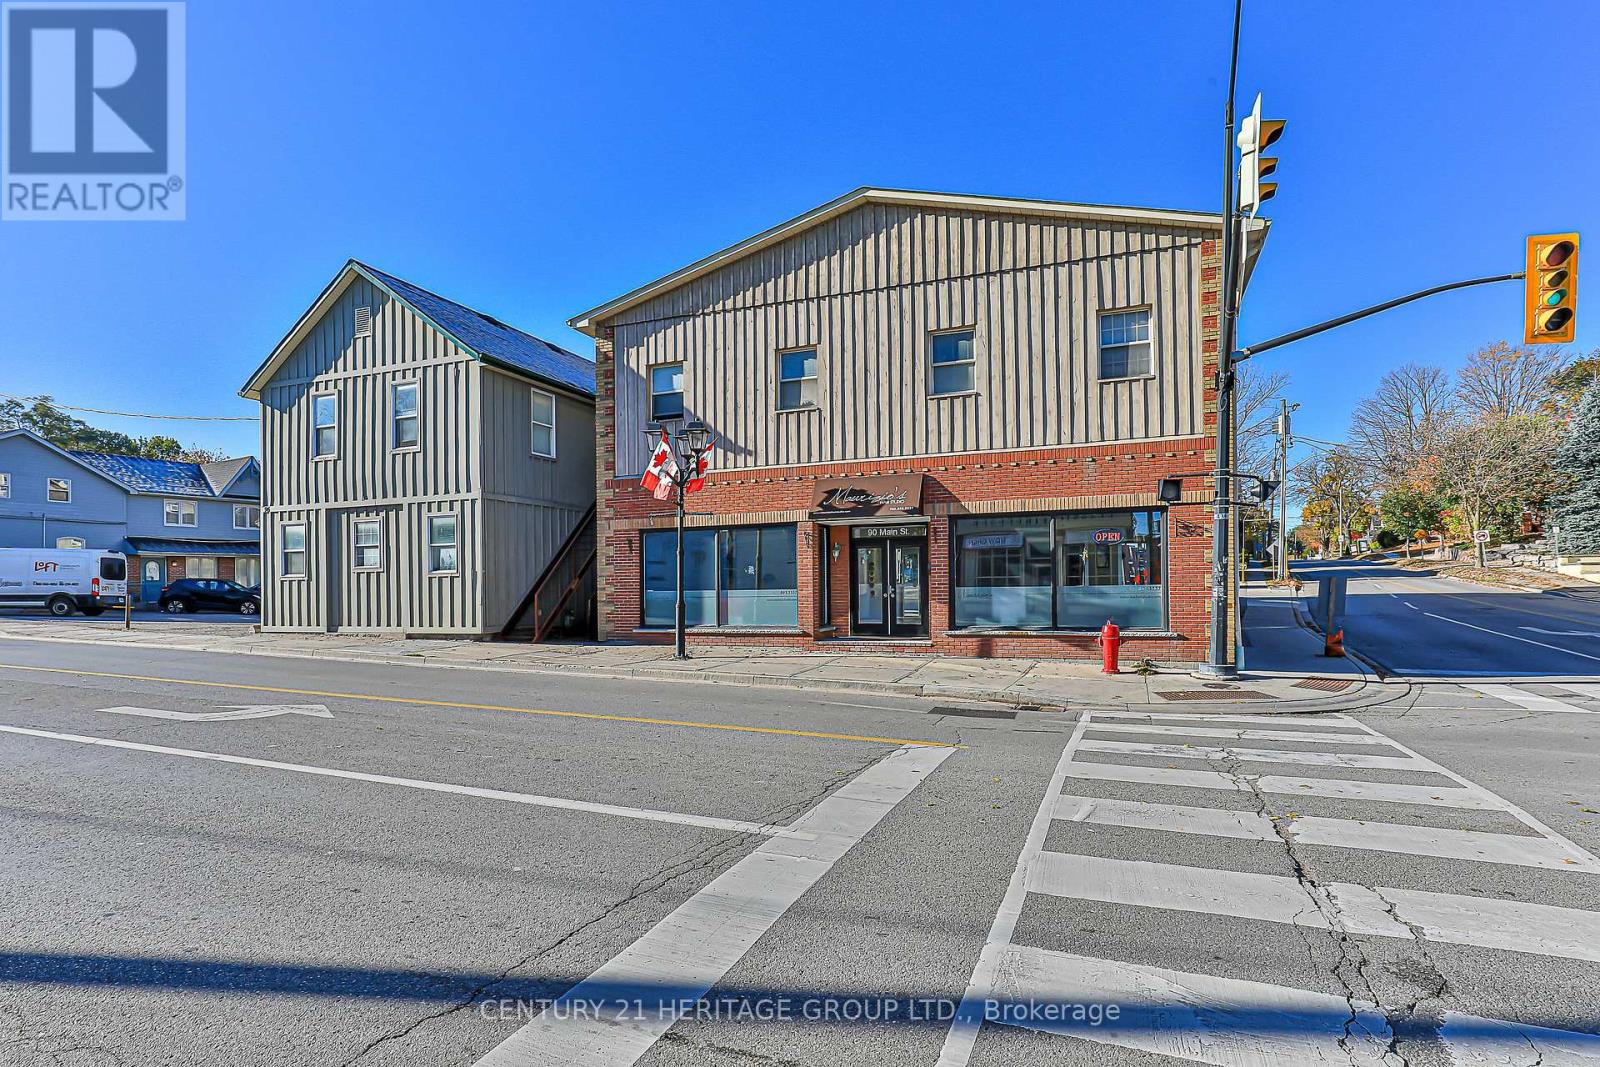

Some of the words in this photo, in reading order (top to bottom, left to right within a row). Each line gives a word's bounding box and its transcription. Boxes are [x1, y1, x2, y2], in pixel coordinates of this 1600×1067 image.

[867, 528, 878, 536] 90
[879, 528, 898, 536] Main
[1095, 532, 1121, 542] OPEN
